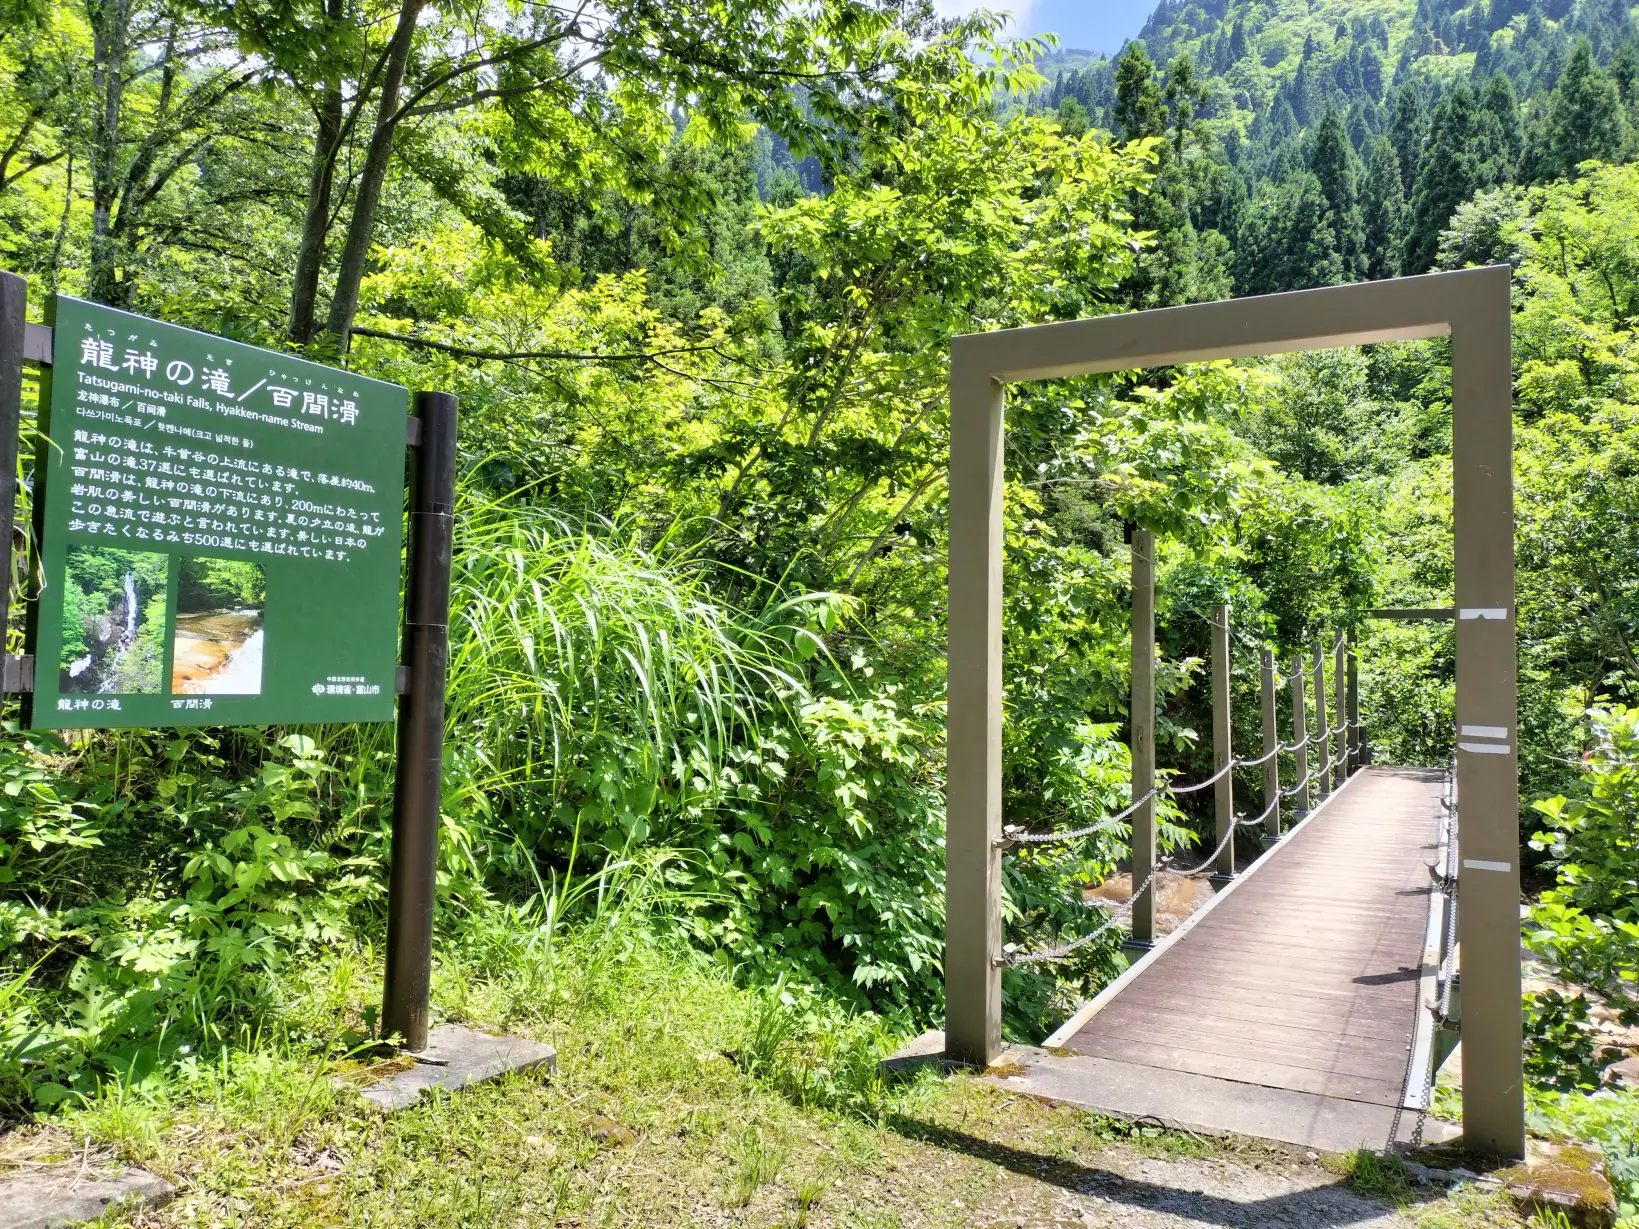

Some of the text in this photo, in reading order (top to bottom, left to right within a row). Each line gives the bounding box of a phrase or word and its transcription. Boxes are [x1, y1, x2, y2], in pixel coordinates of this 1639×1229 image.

[80, 337, 359, 426] 龍神の滝／百間滑
[77, 371, 324, 434] Tatsugami-no-taki Falls, Hyakken-name Stream
[57, 698, 122, 711] 龍神の滝
[170, 698, 213, 710] 百間滑
